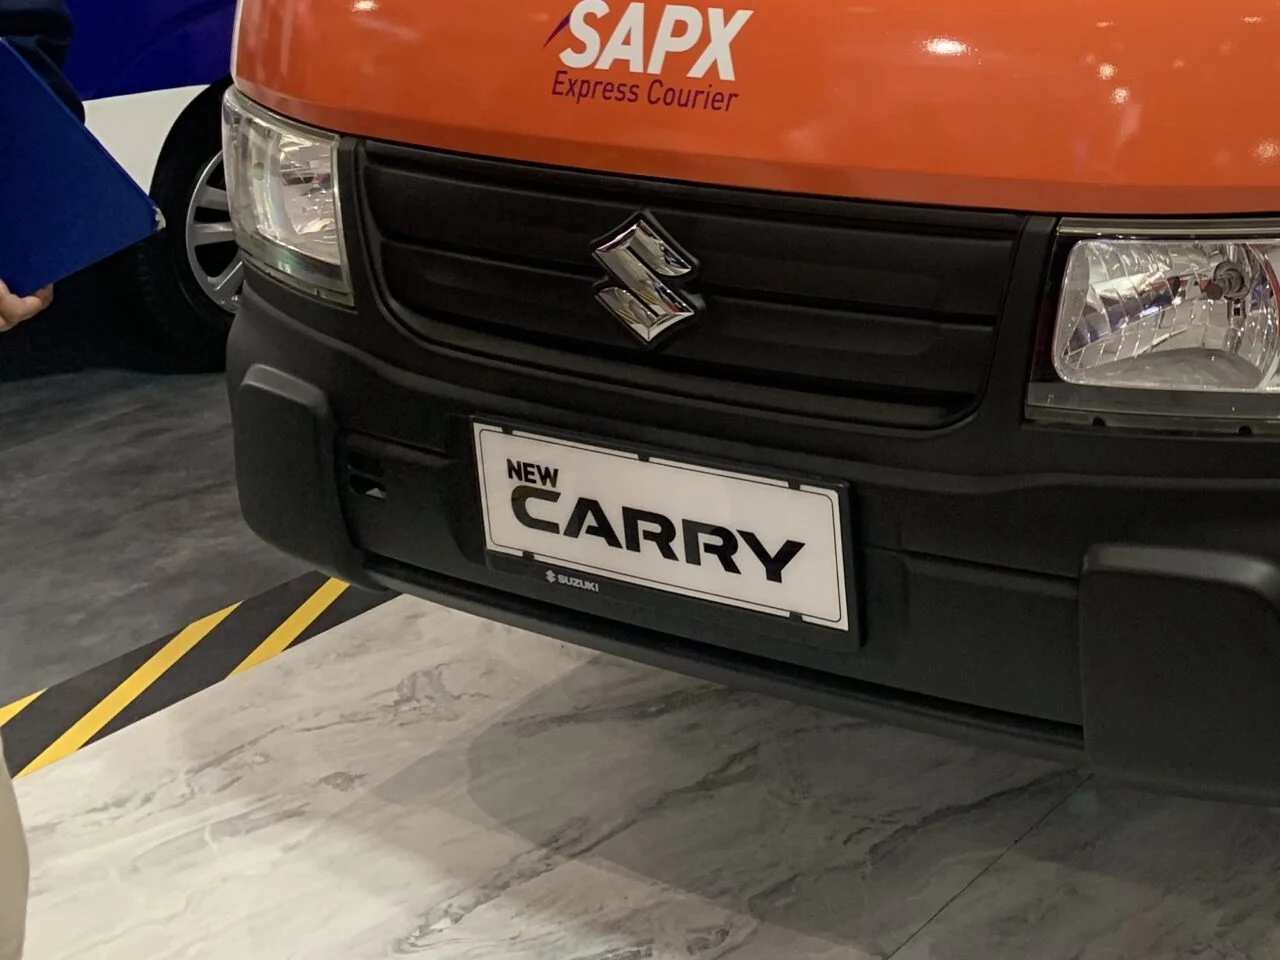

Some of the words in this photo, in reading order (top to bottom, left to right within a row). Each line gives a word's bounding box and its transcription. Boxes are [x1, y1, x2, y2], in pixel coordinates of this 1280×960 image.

[551, 70, 640, 104] Express
[647, 79, 739, 112] Courier
[506, 458, 559, 488] NEW
[511, 485, 806, 584] CARRY
[557, 574, 599, 592] SUZUKI
